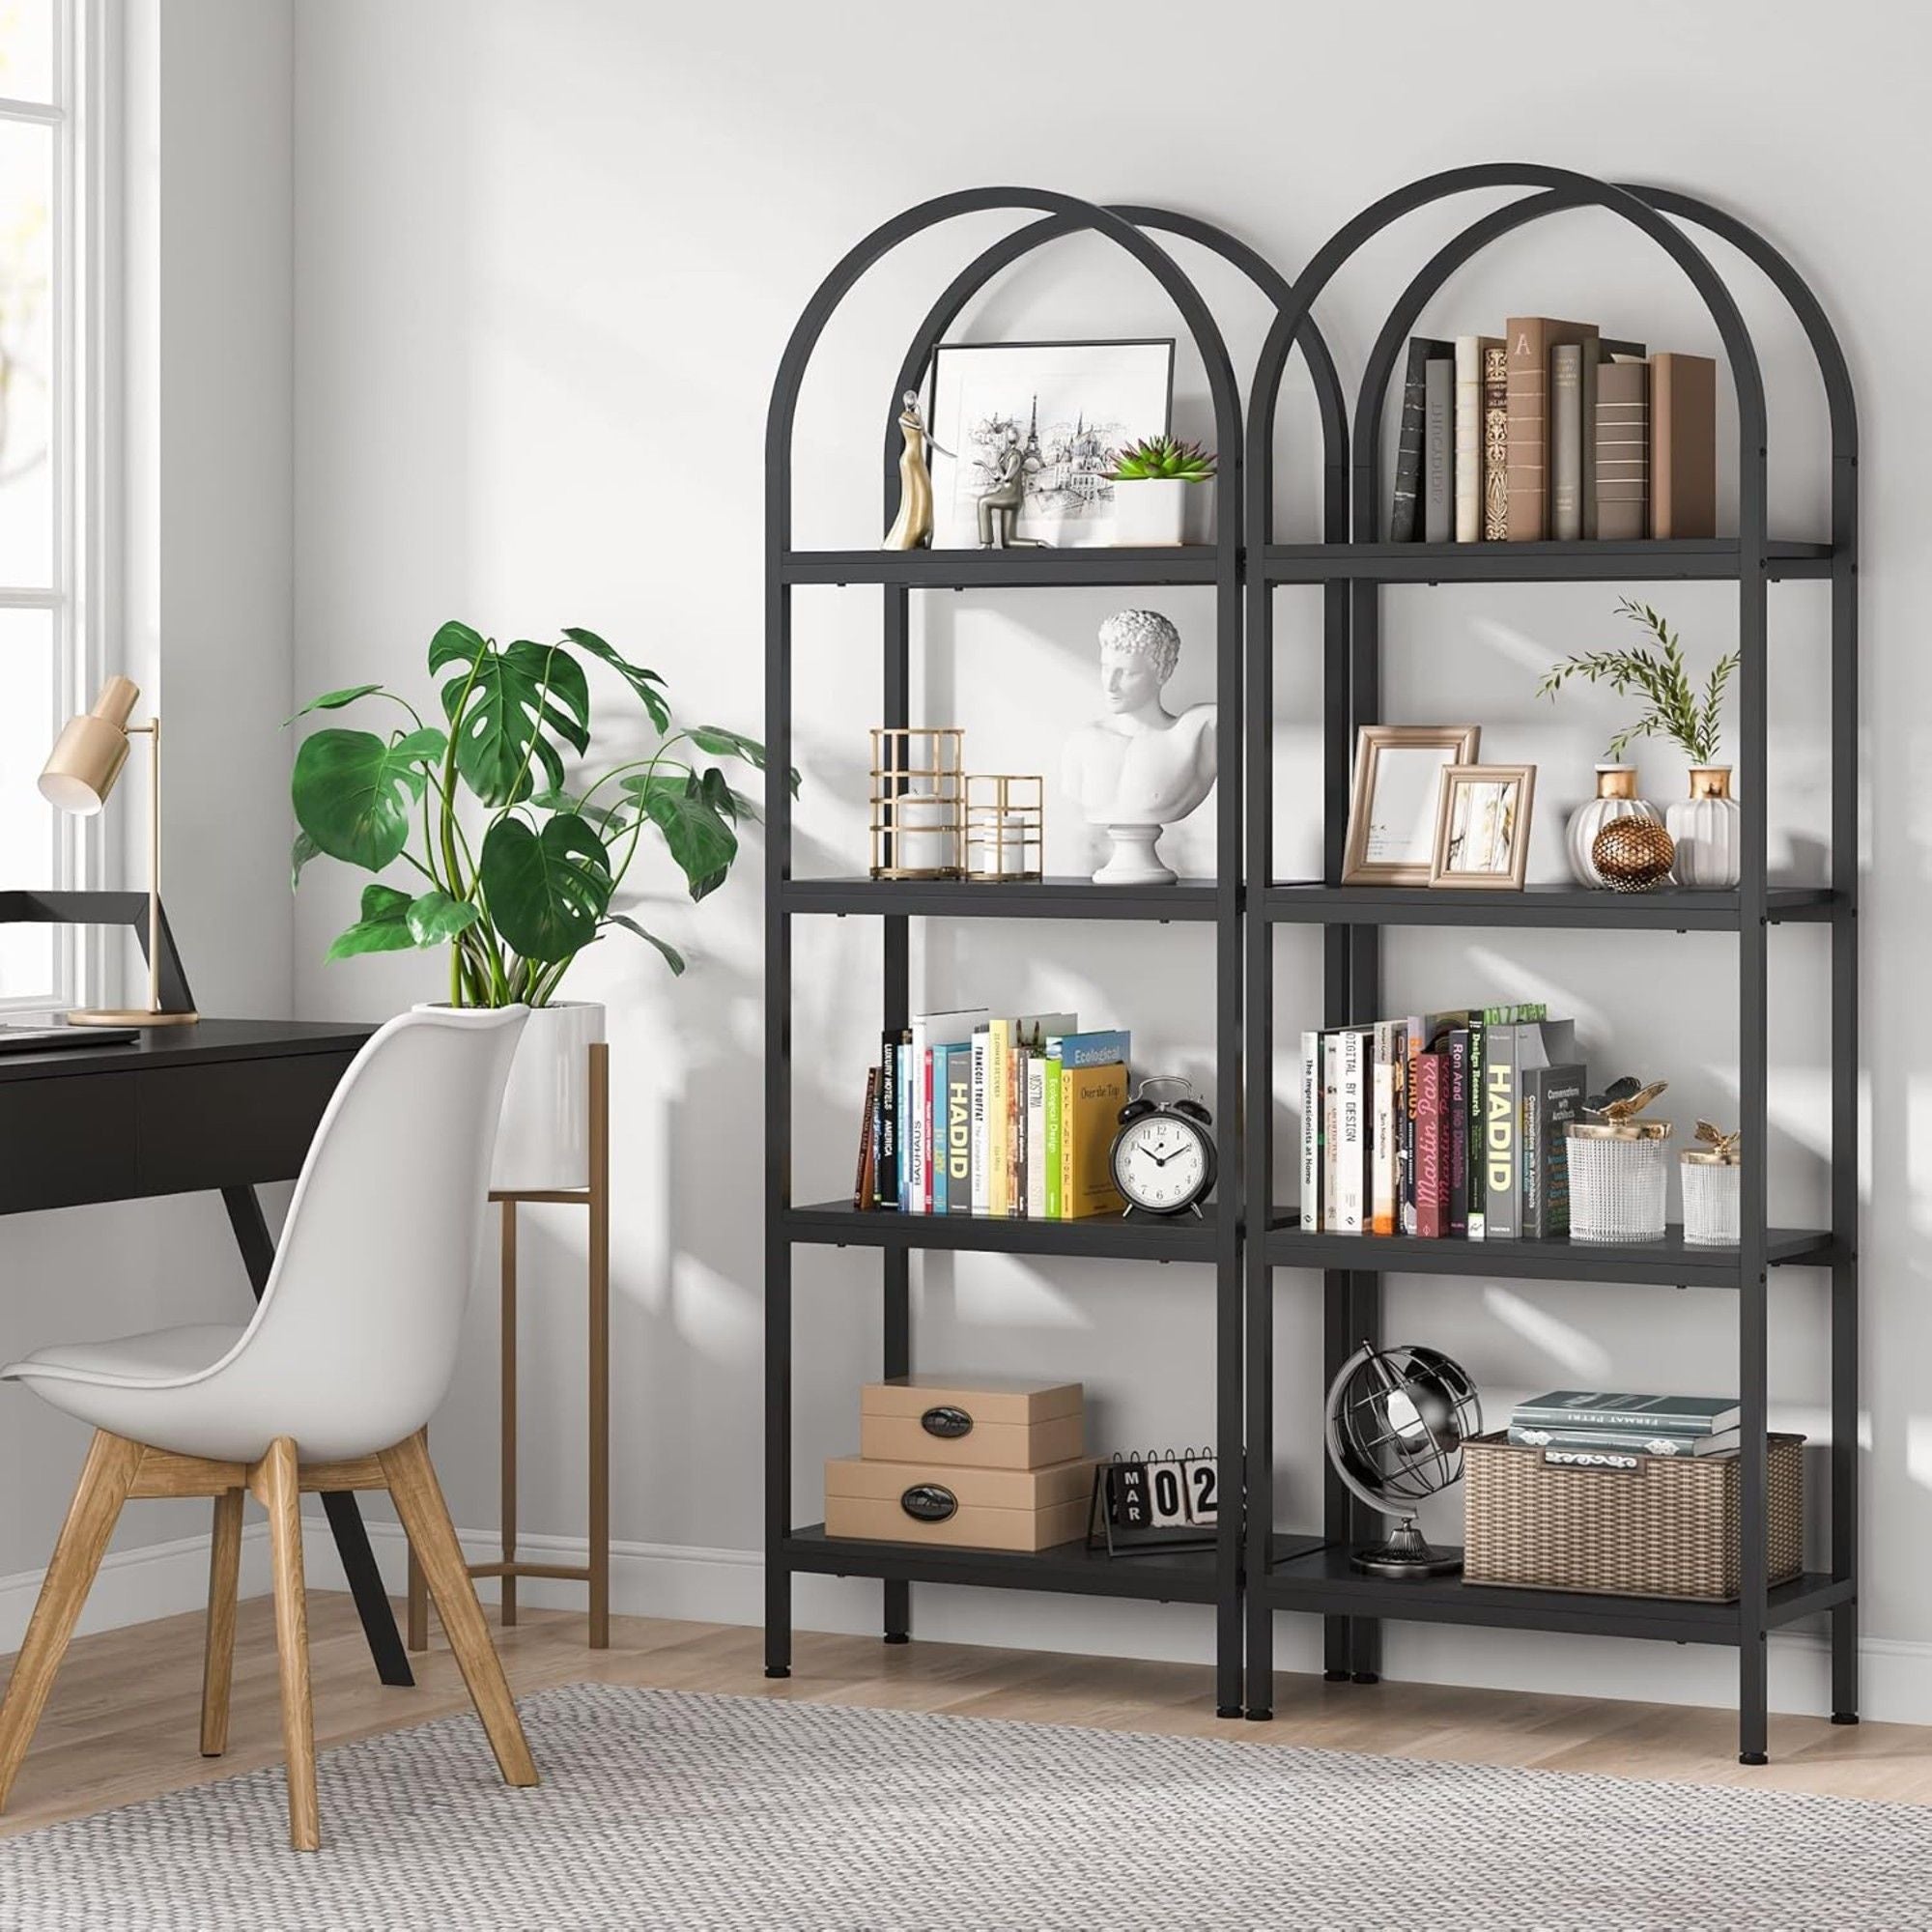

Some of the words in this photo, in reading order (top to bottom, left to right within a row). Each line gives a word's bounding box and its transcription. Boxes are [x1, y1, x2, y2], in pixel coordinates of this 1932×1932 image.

[1515, 333, 1531, 355] A
[884, 1043, 893, 1075] LUXURY
[1074, 1048, 1121, 1065] Ecological
[1345, 1033, 1356, 1075] DIGITAL
[1452, 1043, 1463, 1068] Ron
[1470, 1033, 1481, 1067] Design
[1304, 1060, 1313, 1076] The
[884, 1077, 893, 1110] HOTELS
[1048, 1078, 1058, 1121] Ecological
[1345, 1083, 1356, 1095] BY
[1417, 1058, 1438, 1116] Parr
[1452, 1071, 1463, 1101] Arad
[1471, 1069, 1481, 1117] Research
[1303, 1077, 1313, 1144] Impressionists
[1345, 1102, 1356, 1142] DESIGN
[884, 1120, 893, 1156] AMERICA
[949, 1082, 969, 1179] HADID
[1048, 1123, 1058, 1152] Design
[1488, 1064, 1512, 1192] HADID
[1304, 1147, 1313, 1157] at
[1417, 1121, 1438, 1208] Martin
[1304, 1158, 1313, 1184] Home
